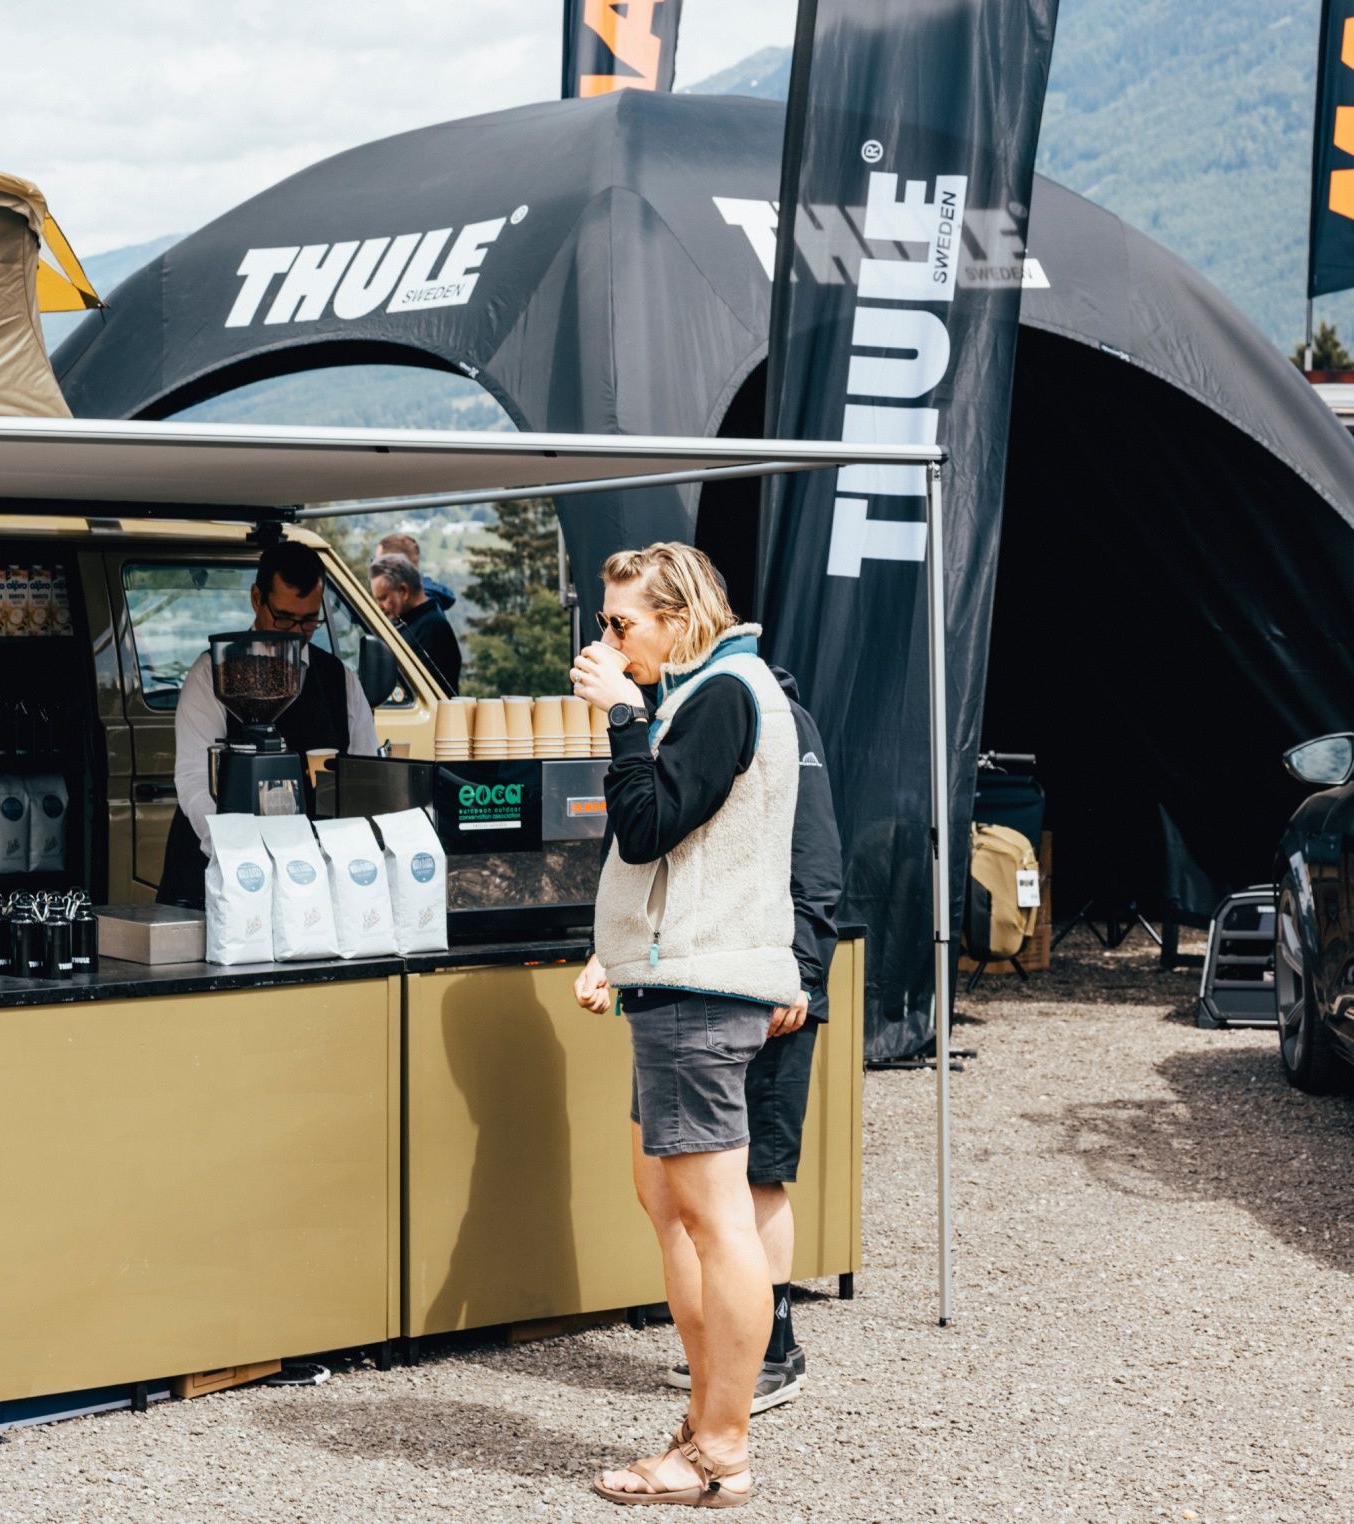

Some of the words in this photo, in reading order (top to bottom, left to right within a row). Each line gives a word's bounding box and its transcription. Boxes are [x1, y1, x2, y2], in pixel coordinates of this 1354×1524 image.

[933, 190, 957, 284] SWEDEN
[224, 217, 507, 328] THULE
[964, 264, 1034, 285] SWEDEN
[401, 284, 466, 304] SWEDEN
[826, 171, 968, 578] THULE
[6, 580, 27, 591] alpro
[30, 580, 50, 591] alpro
[458, 783, 522, 806] eoca
